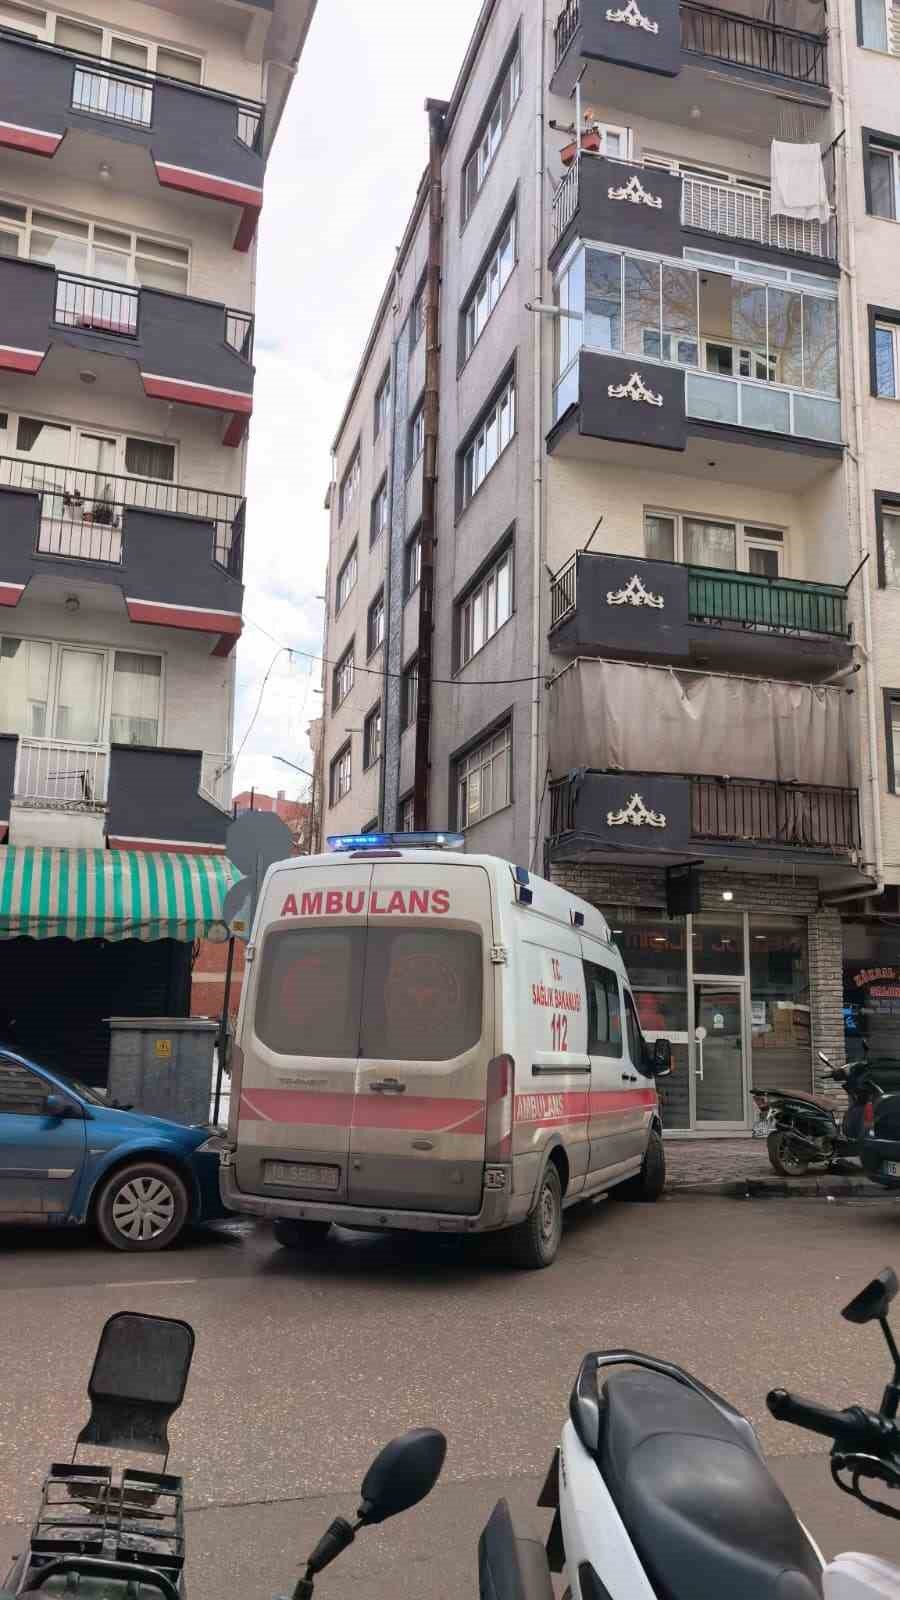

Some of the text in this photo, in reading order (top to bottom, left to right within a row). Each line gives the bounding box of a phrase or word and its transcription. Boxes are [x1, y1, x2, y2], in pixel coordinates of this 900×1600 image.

[280, 889, 450, 916] AMBULANS
[551, 1013, 568, 1052] 112
[515, 1095, 565, 1121] AMBULANS
